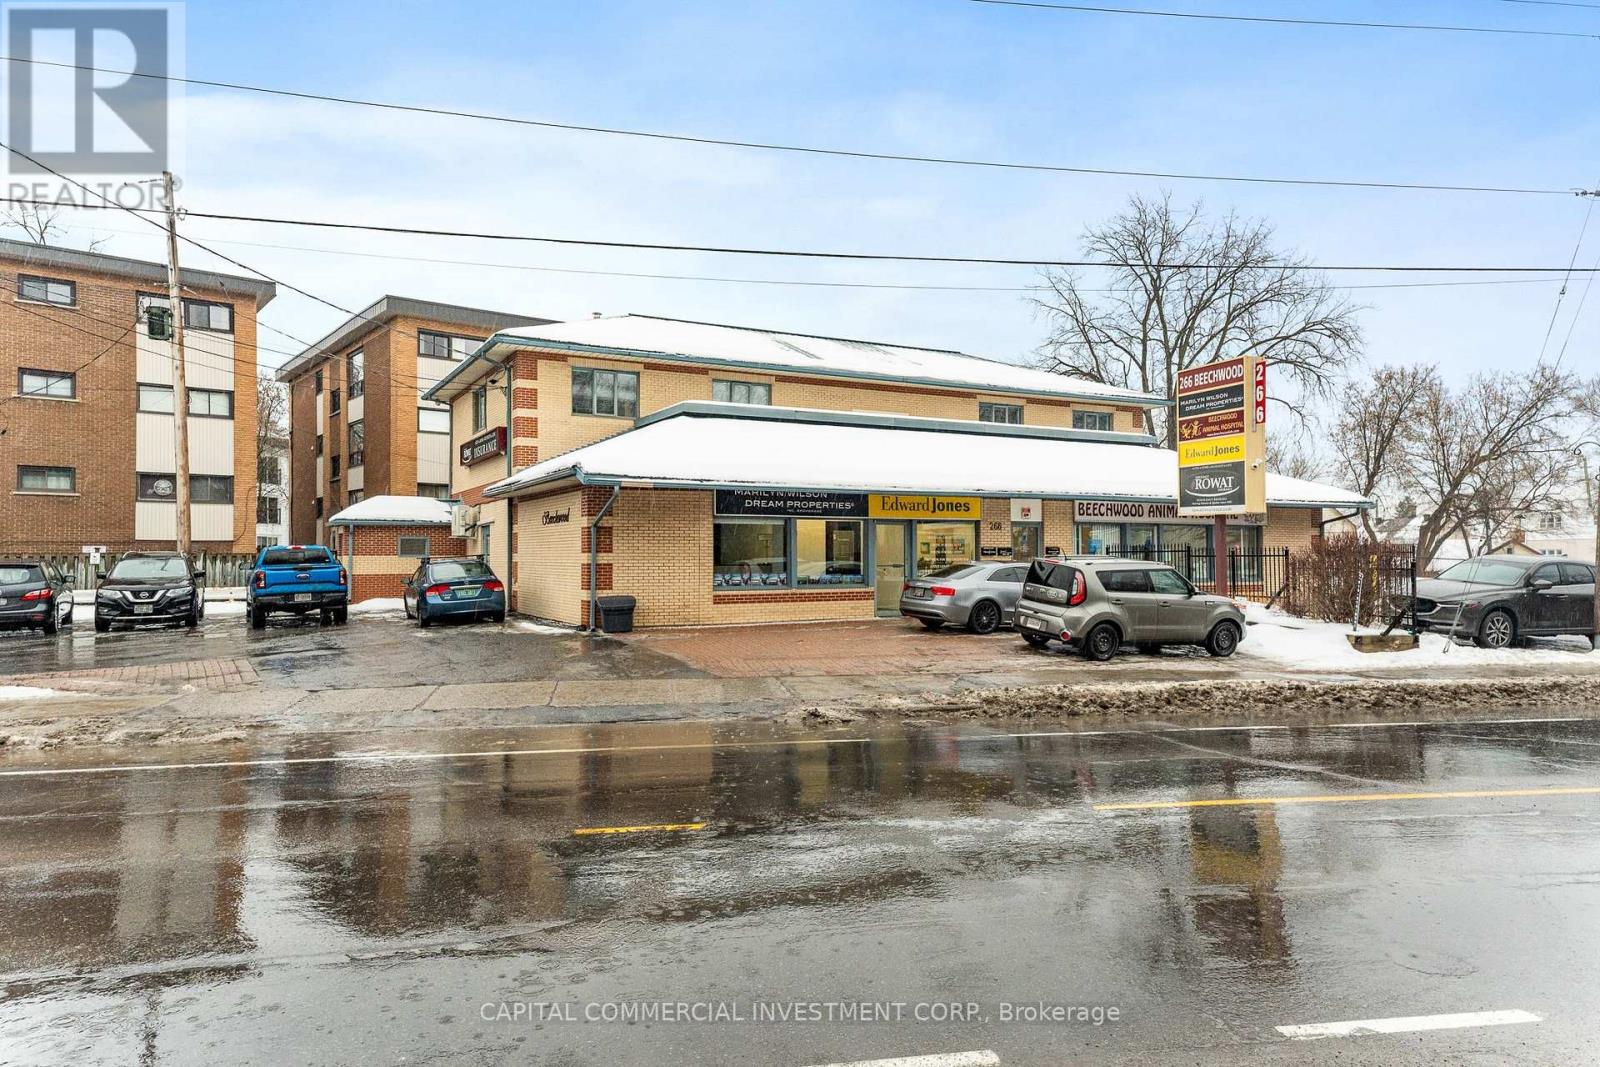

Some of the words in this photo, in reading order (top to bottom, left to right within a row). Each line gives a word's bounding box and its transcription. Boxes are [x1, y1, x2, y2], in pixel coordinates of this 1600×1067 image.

[1179, 375, 1193, 390] 266
[1194, 364, 1244, 387] BEECHWOOD
[1180, 397, 1205, 405] MARILYN
[1206, 392, 1229, 401] WILSON
[1185, 403, 1205, 411] DREAM
[1194, 476, 1235, 490] ROWAT
[744, 499, 784, 508] DREAM
[1078, 502, 1144, 518] BEECHWOOD
[1148, 505, 1187, 519] ANIM
